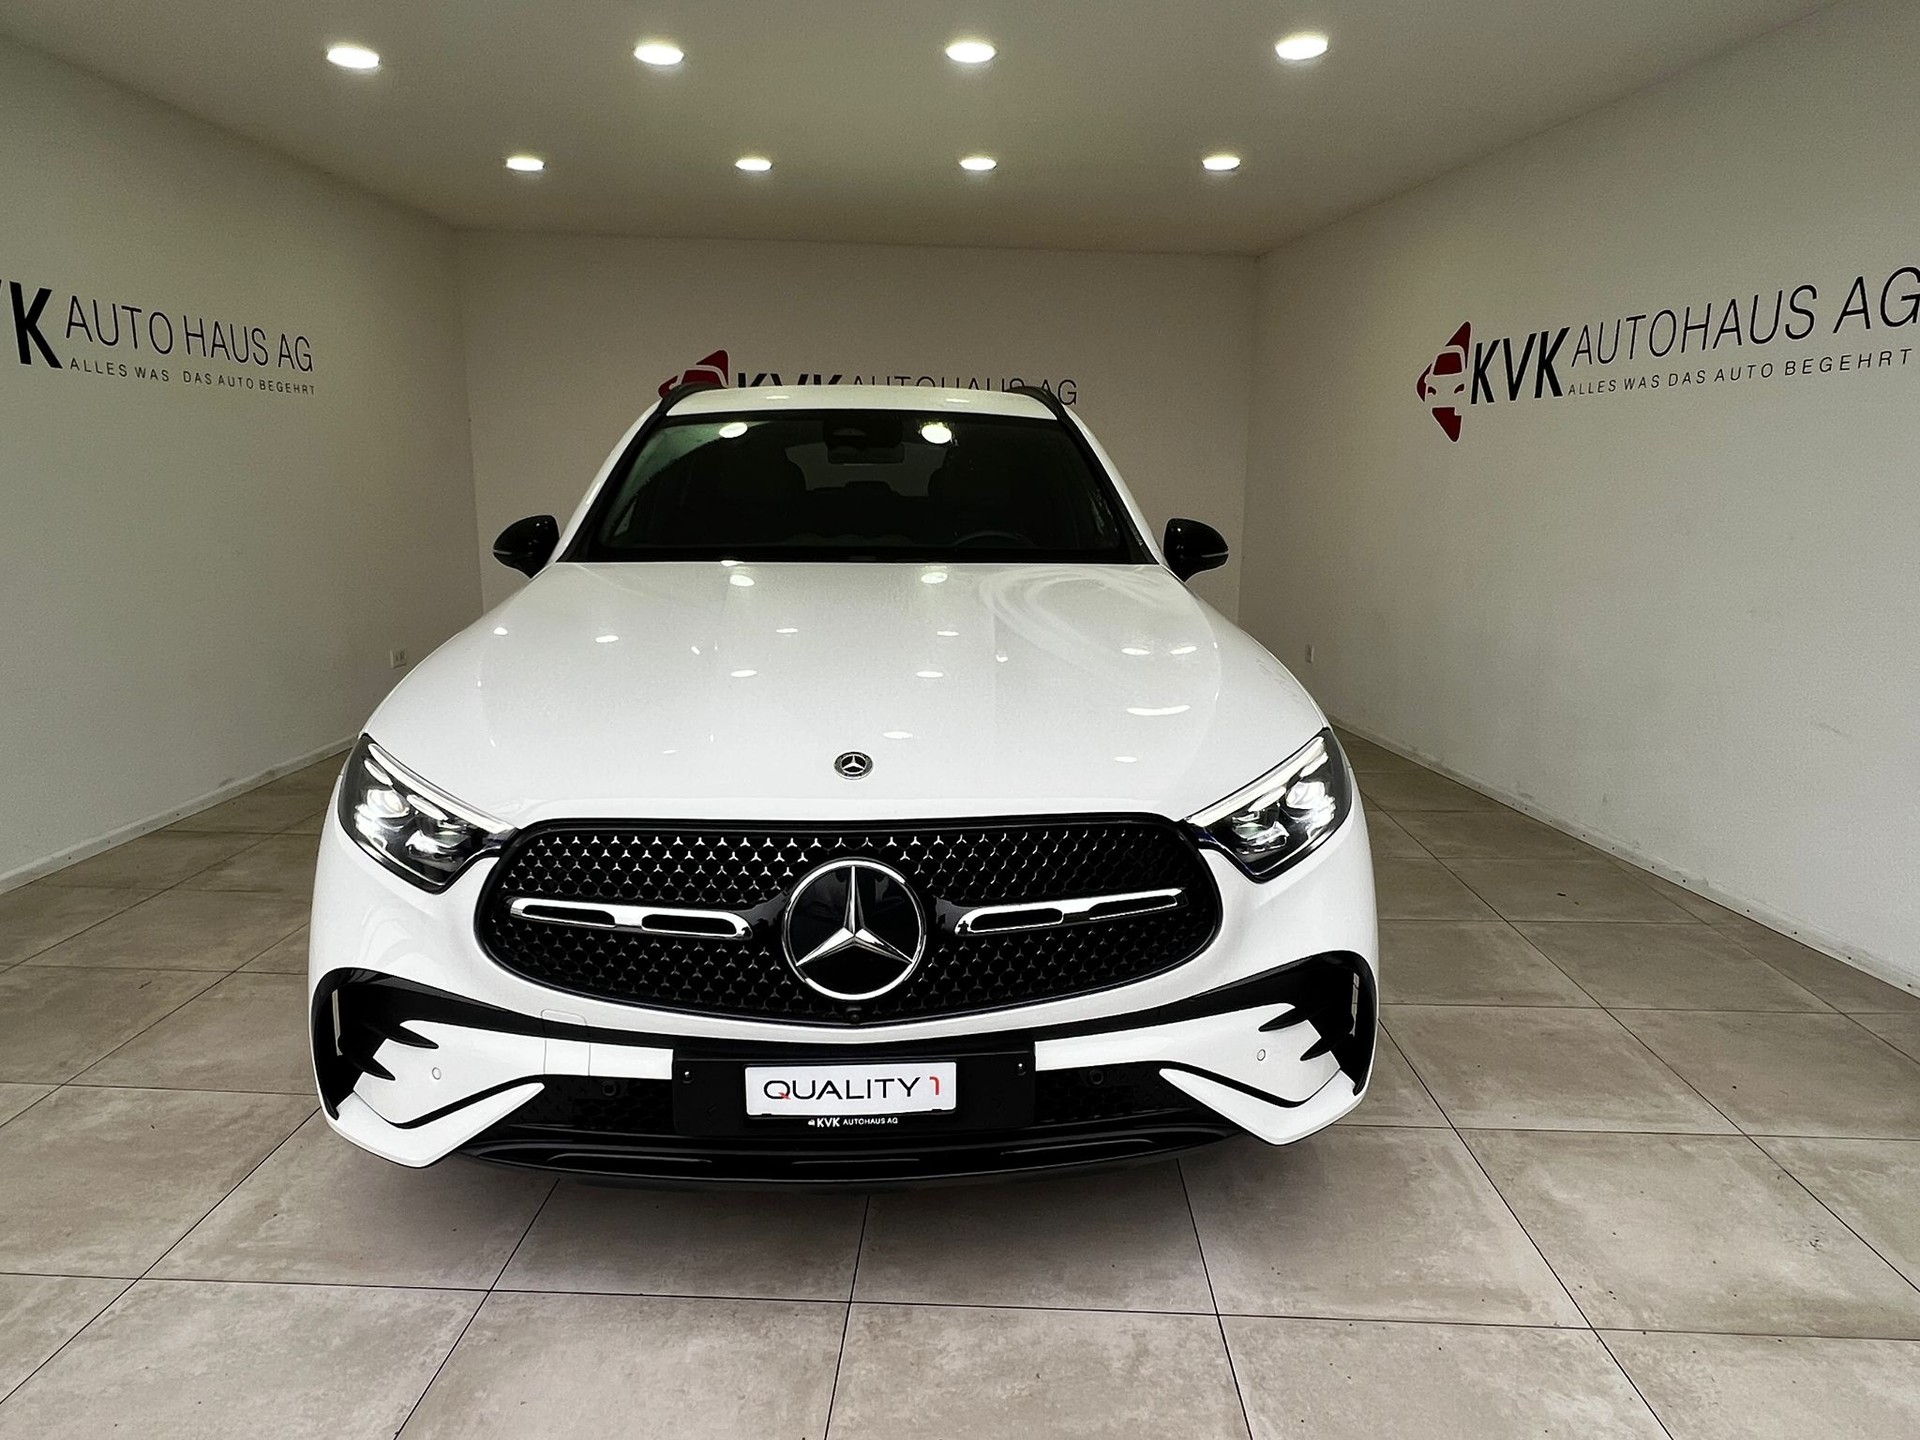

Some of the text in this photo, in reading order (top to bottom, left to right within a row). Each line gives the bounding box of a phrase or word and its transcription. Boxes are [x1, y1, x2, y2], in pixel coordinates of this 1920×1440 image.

[0, 279, 63, 369] K
[278, 333, 313, 372] AG
[1470, 266, 1920, 405] KVK AUTOHAUS AG
[70, 357, 315, 395] ALLES WAS DAS AUTO BEGEHRT
[1568, 348, 1912, 396] ALLES WAS DAS AUTO BEGEHRT
[763, 1076, 940, 1100] QUALITY 1
[816, 1117, 840, 1128] KVK
[842, 1117, 886, 1126] AUTOHAUS
